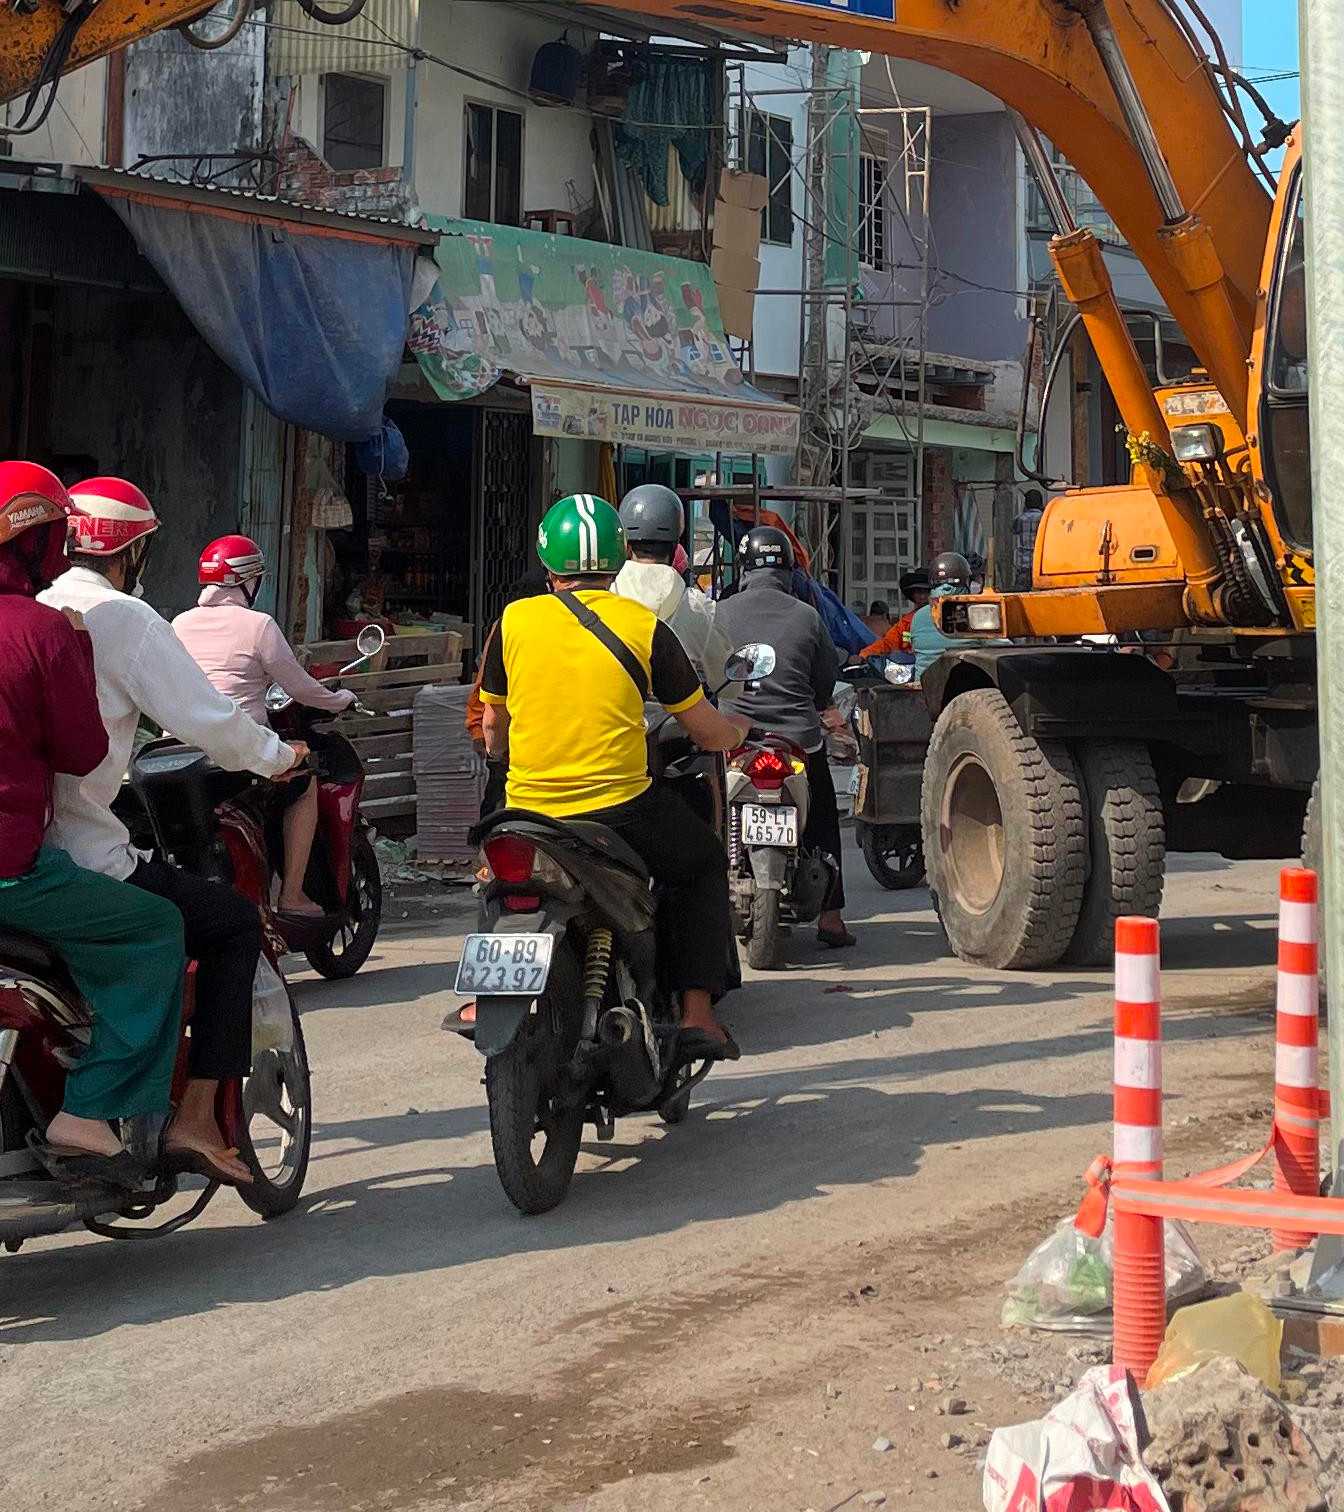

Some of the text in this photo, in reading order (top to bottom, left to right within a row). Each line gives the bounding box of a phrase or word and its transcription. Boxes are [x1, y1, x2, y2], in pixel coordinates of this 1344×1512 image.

[612, 402, 640, 430] TẠP
[678, 406, 739, 437] NGỌC
[7, 505, 46, 524] YAMAHA
[476, 939, 538, 964] 60-B9
